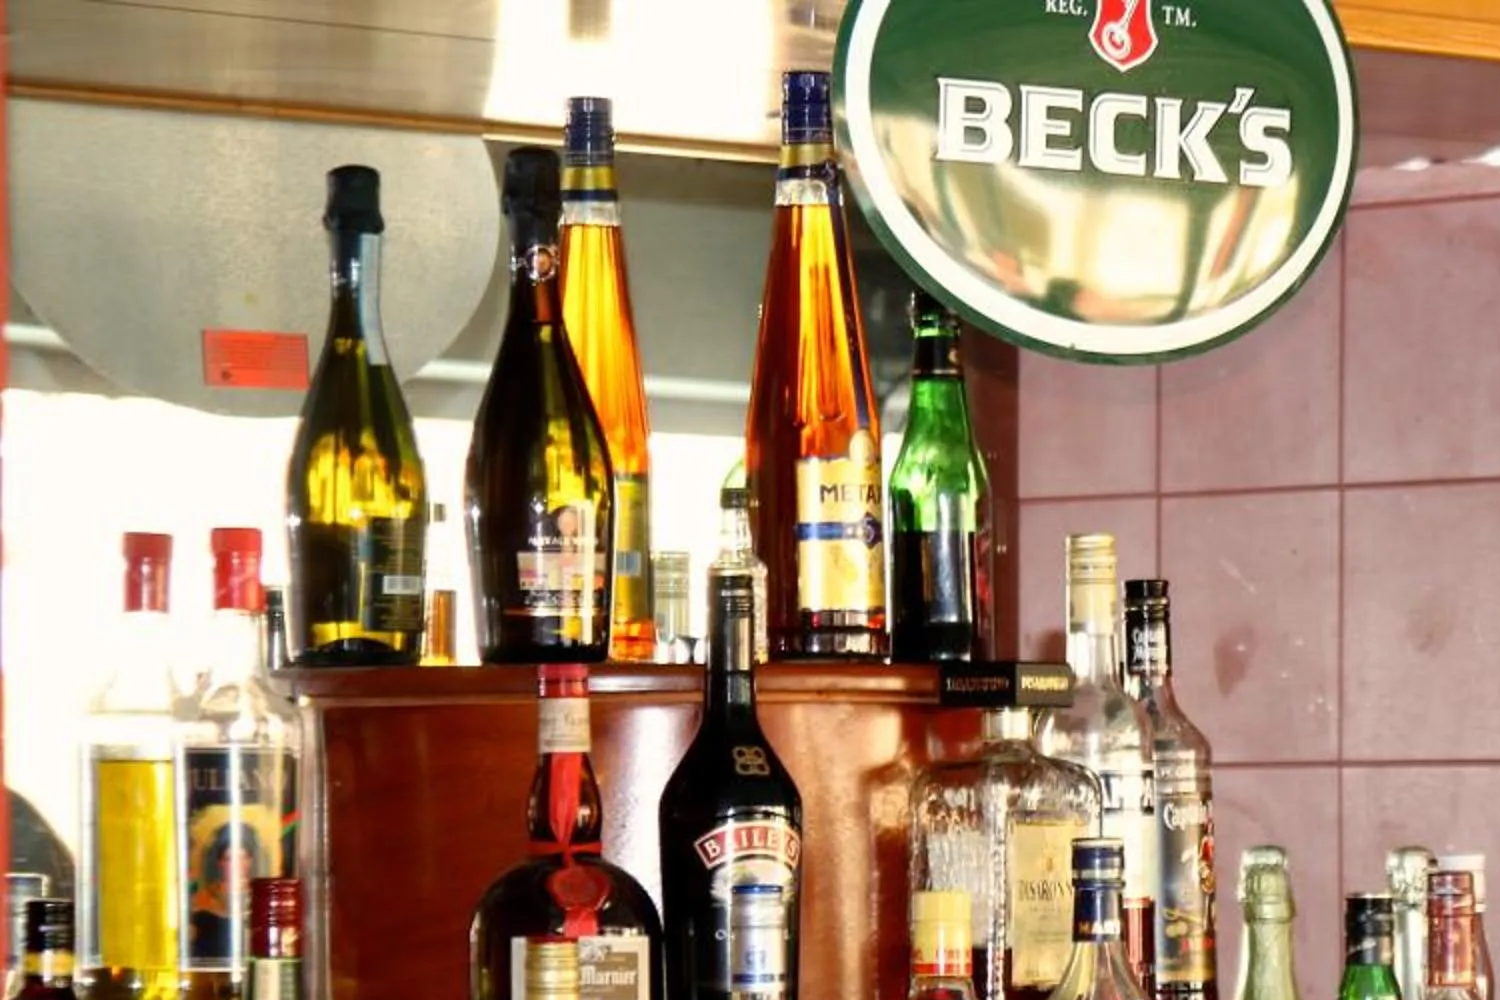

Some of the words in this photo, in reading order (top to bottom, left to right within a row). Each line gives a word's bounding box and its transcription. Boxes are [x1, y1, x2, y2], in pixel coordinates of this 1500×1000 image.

[1162, 5, 1197, 27] TM.
[935, 77, 1293, 188] BECK'S
[820, 483, 881, 504] META
[703, 825, 797, 860] BILES
